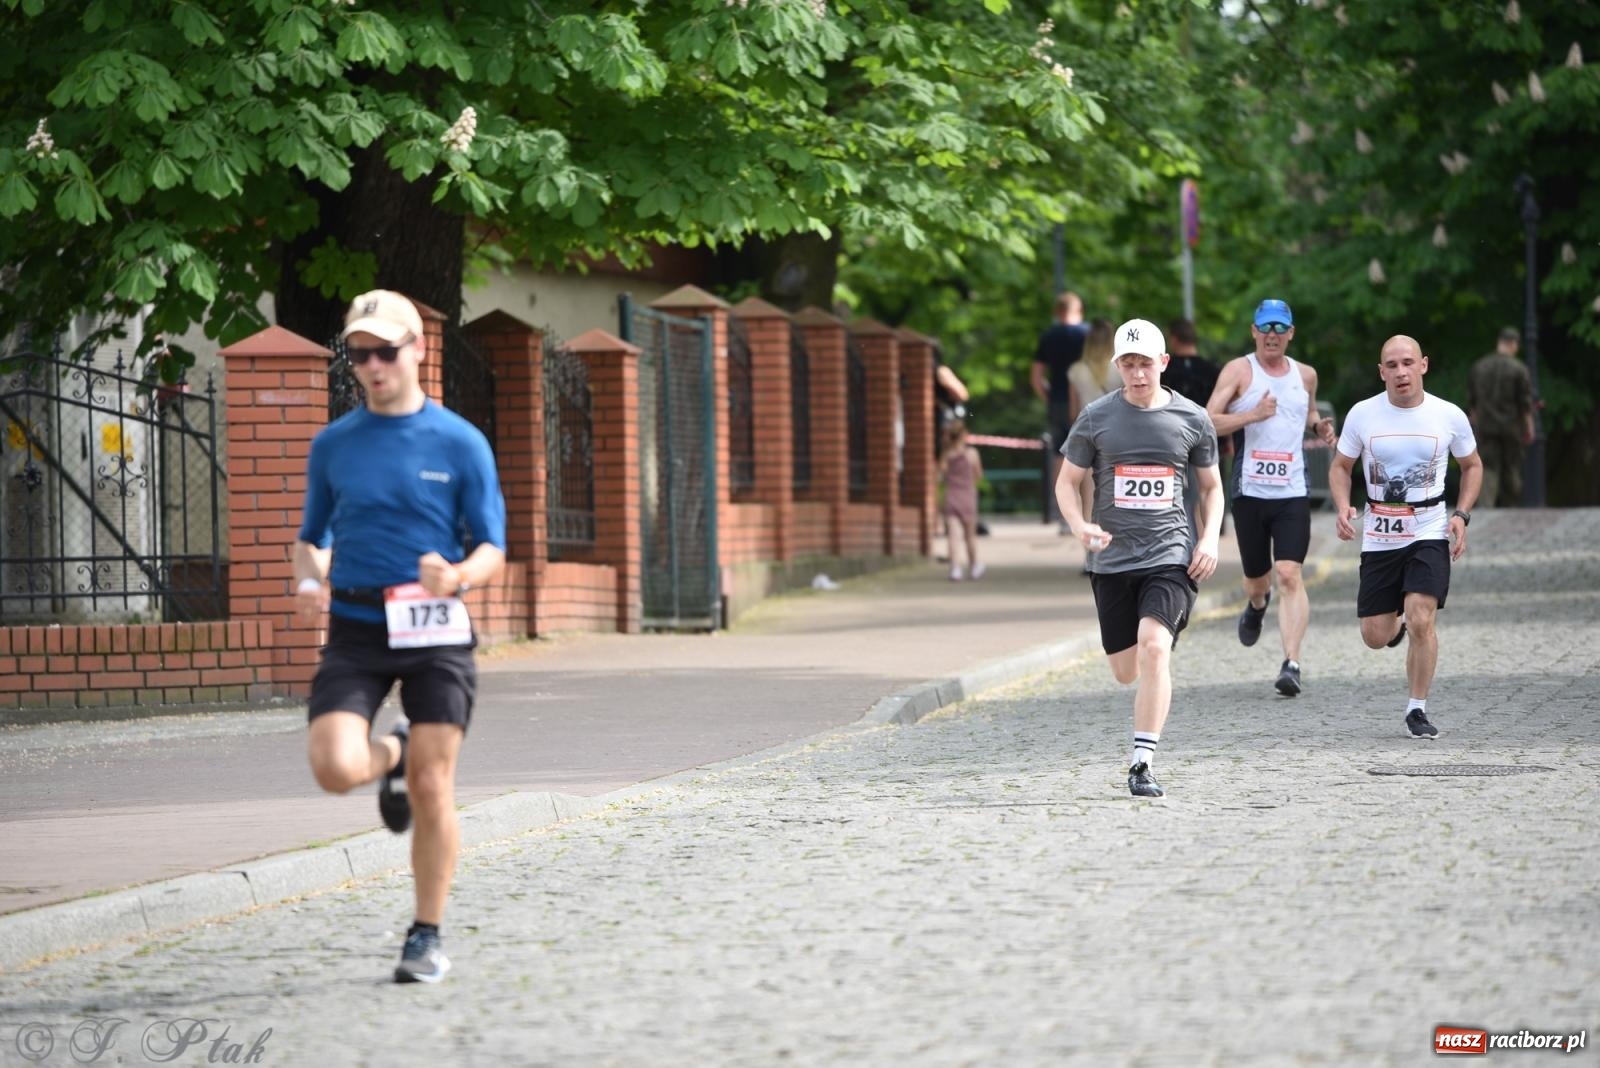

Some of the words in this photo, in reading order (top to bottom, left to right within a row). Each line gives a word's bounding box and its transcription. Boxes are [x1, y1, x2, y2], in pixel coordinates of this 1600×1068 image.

[1255, 461, 1287, 476] 208
[1124, 479, 1165, 497] 209
[1374, 516, 1404, 534] 214
[409, 603, 449, 627] 173
